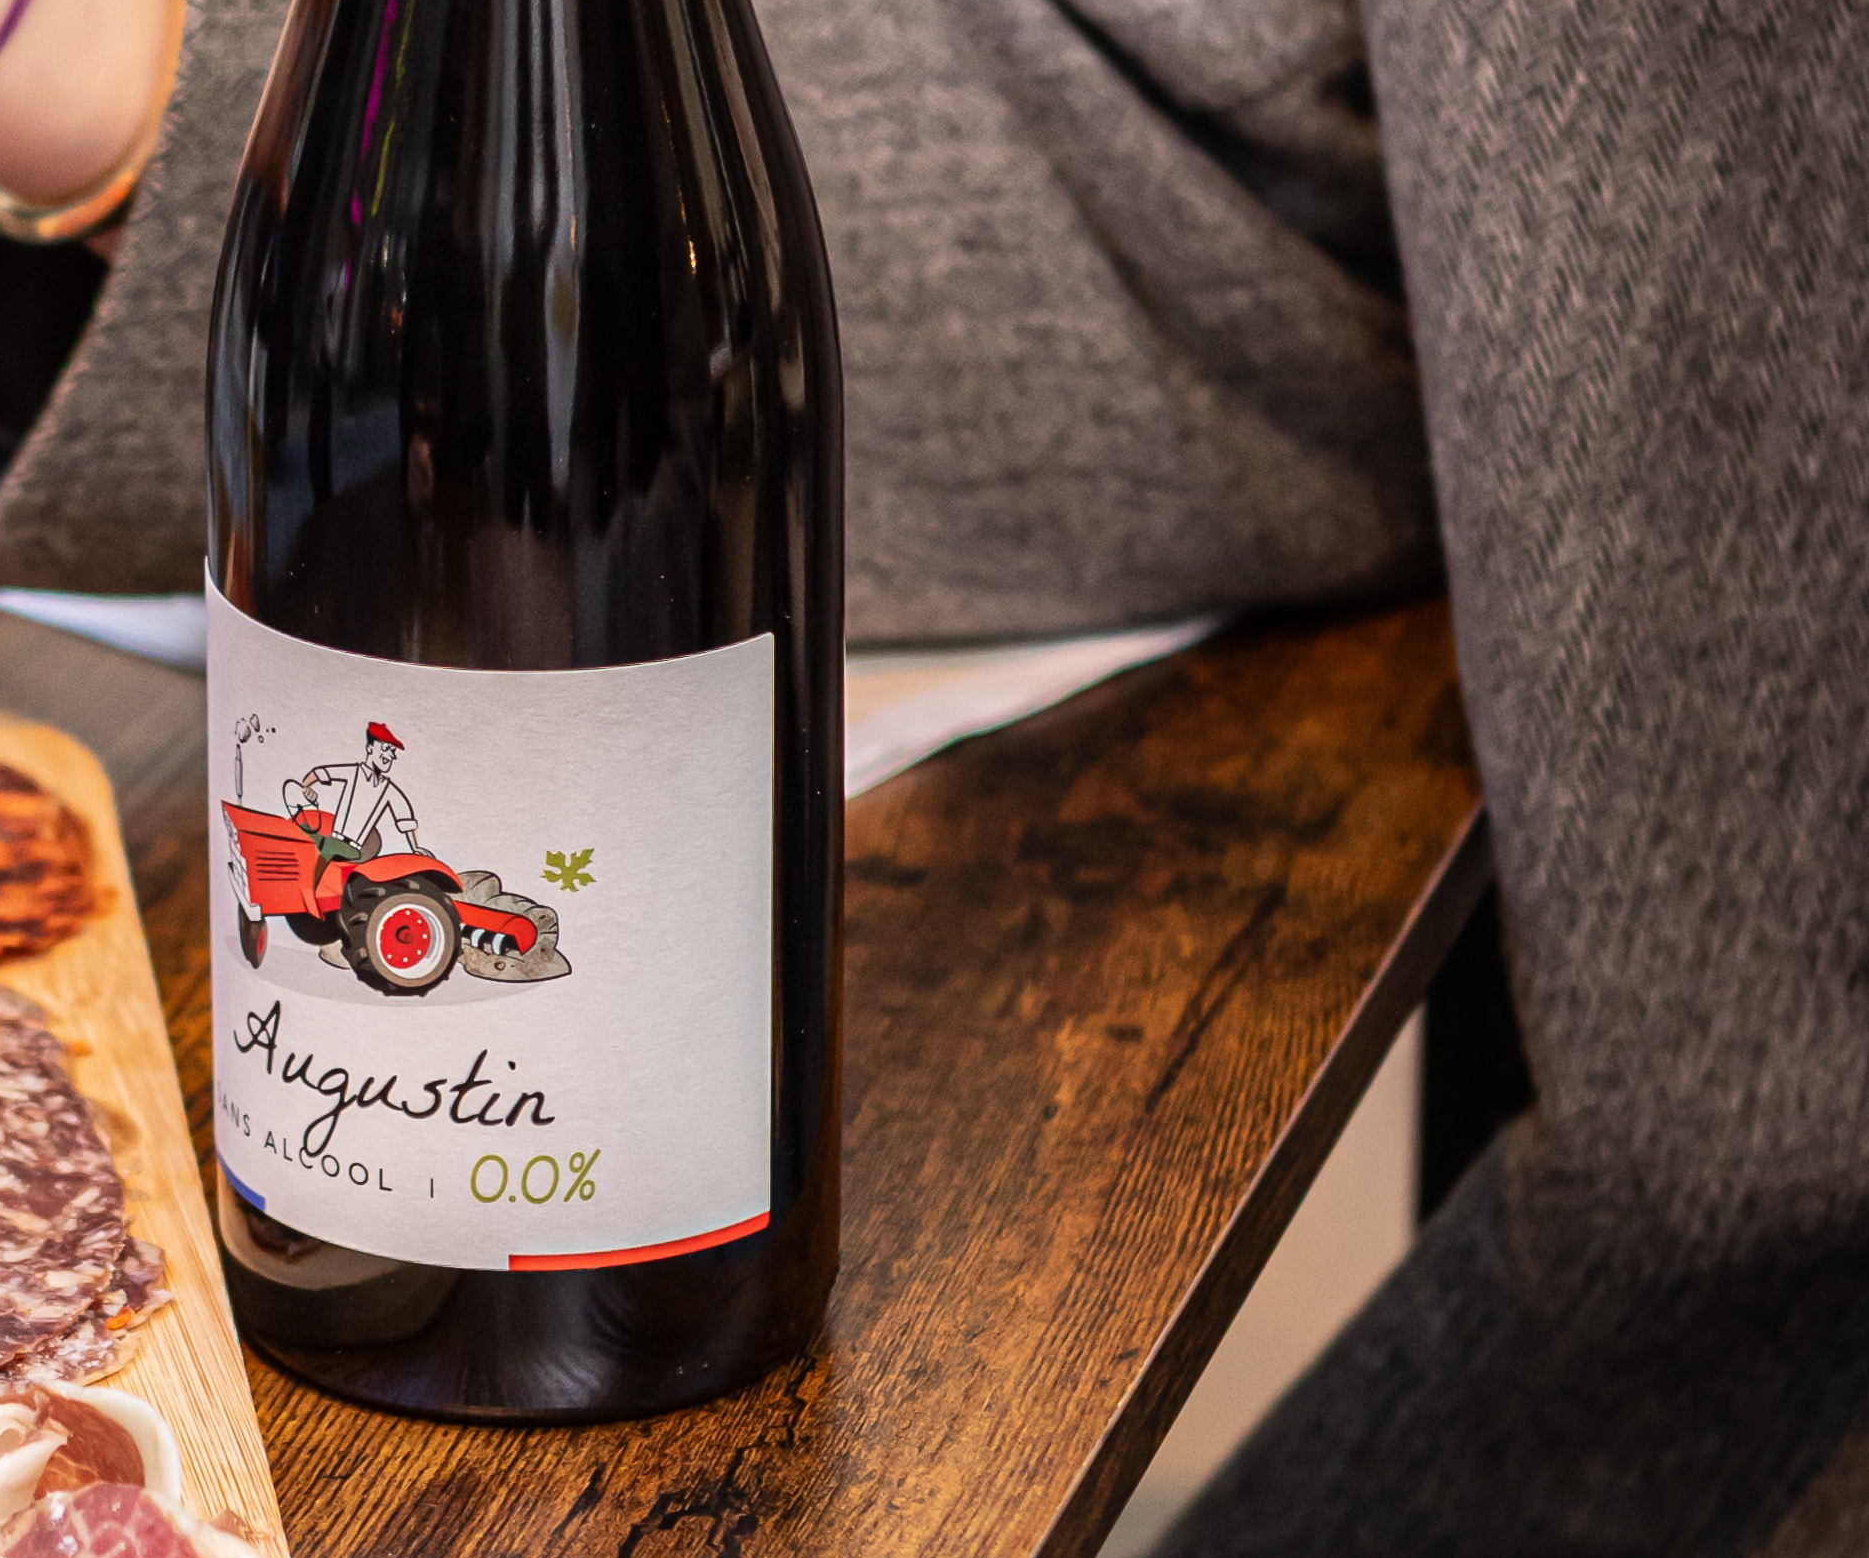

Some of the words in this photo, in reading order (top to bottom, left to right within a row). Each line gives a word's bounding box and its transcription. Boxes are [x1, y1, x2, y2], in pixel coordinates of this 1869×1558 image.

[233, 1000, 556, 1158] Augustin
[263, 1130, 393, 1192] ALCOOL
[470, 1149, 601, 1204] 0.0%
